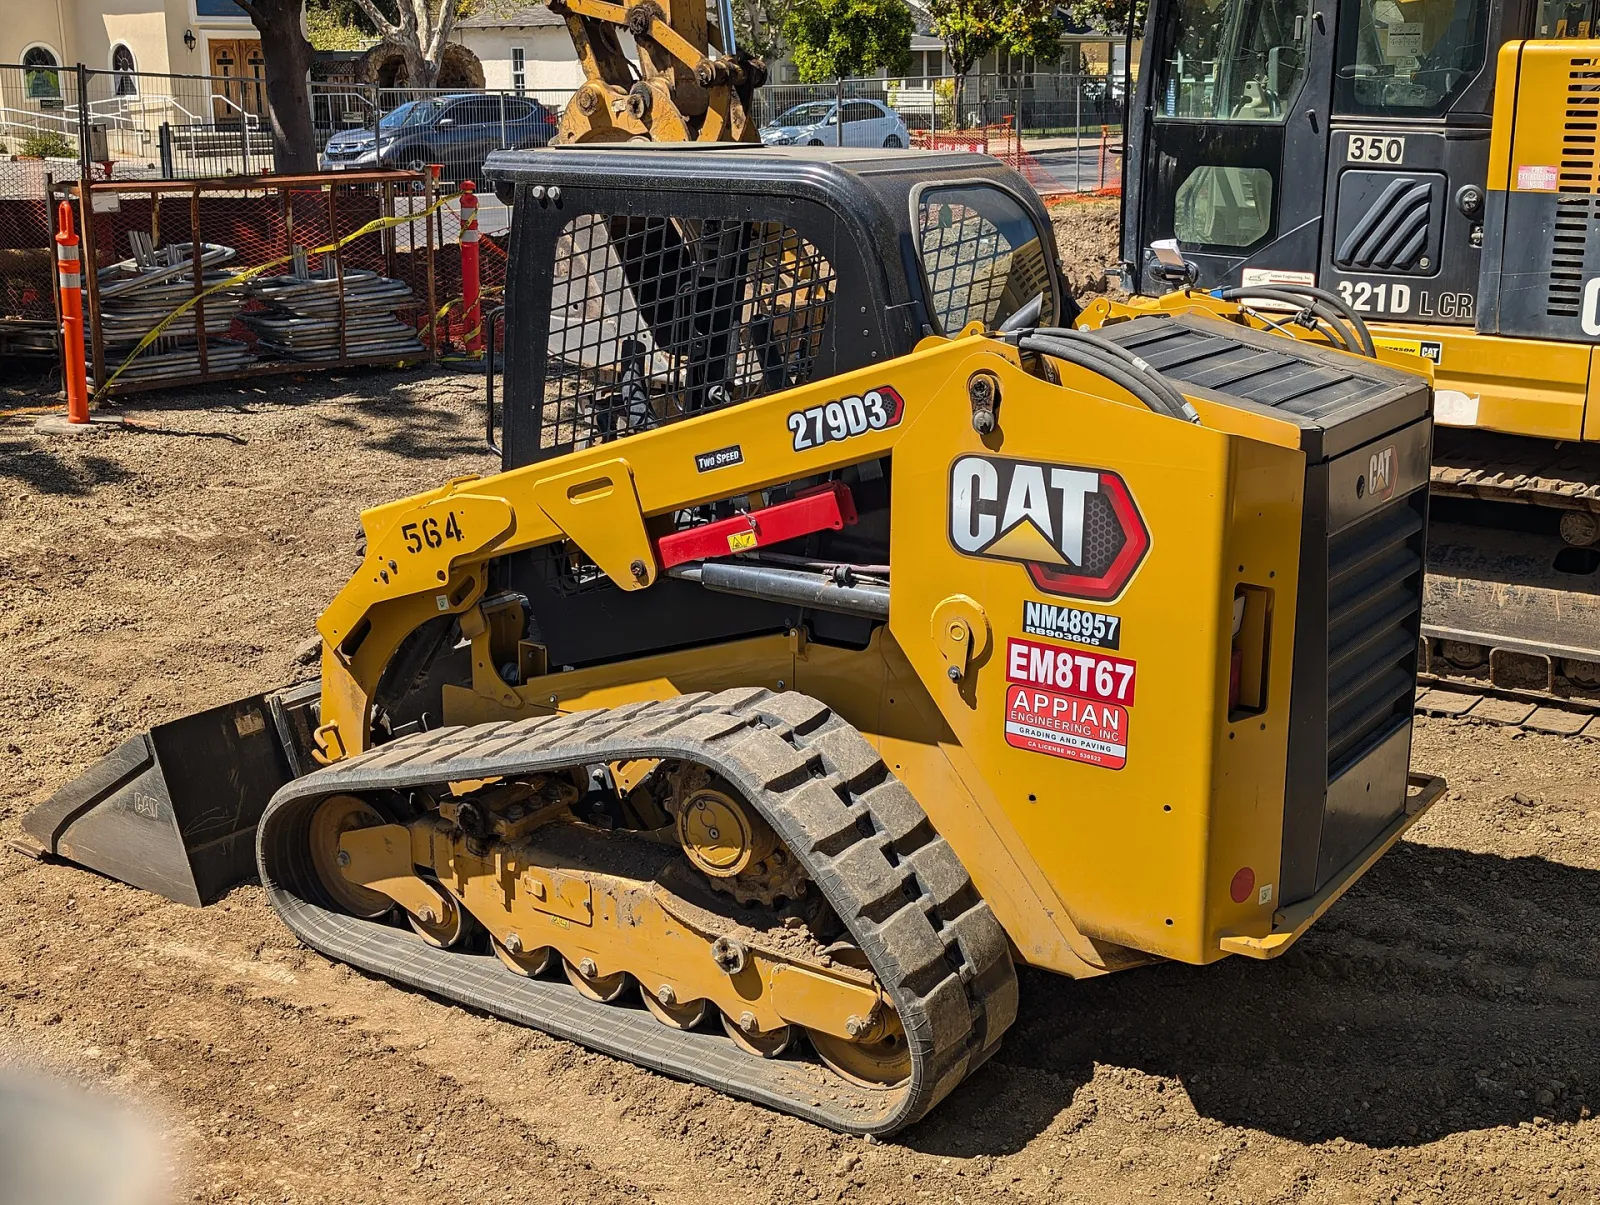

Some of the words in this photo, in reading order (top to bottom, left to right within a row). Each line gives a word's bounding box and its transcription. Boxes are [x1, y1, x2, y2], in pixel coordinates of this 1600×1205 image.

[1350, 137, 1403, 163] 350
[1336, 280, 1411, 314] 321D
[1418, 291, 1434, 316] L
[1437, 292, 1474, 318] CR
[1421, 347, 1440, 358] CAT
[789, 391, 888, 450] 279D3
[1369, 447, 1392, 495] CAT
[952, 457, 1099, 567] CAT
[401, 511, 462, 553] 564
[1025, 625, 1100, 645] RB903605
[1026, 601, 1119, 641] NM48957
[1009, 643, 1134, 700] EM8T67
[1012, 690, 1120, 730] APPIAN
[1019, 727, 1057, 741] GRADING
[1060, 735, 1077, 745] AND
[1080, 740, 1112, 753] PAVING
[1038, 743, 1065, 754] LICENSE
[1066, 749, 1078, 757] NO.
[1099, 729, 1123, 743] INC.
[134, 792, 158, 819] CAT
